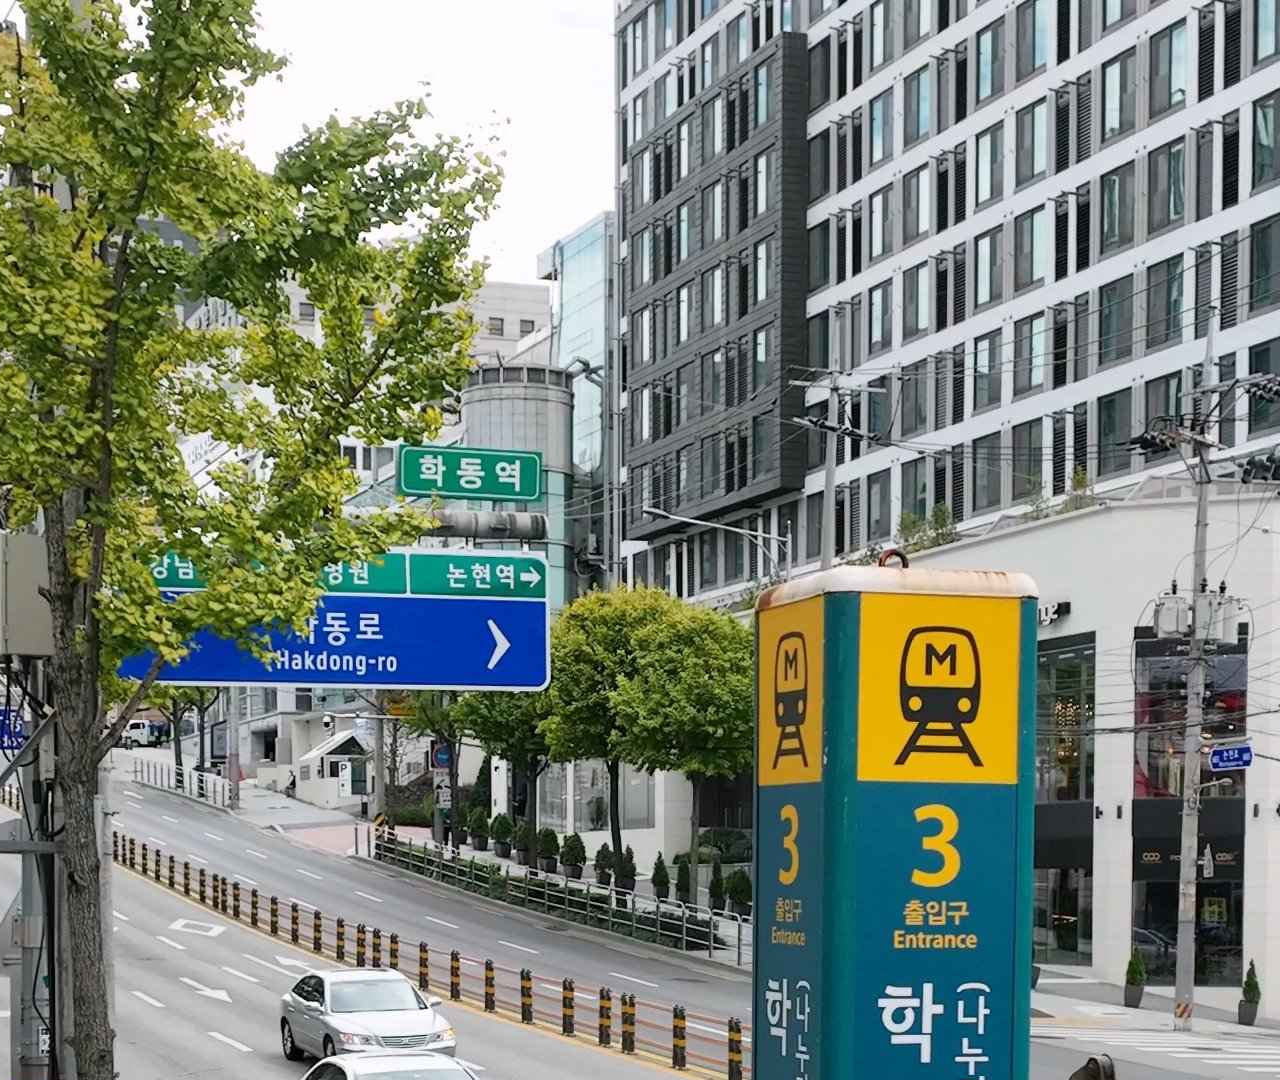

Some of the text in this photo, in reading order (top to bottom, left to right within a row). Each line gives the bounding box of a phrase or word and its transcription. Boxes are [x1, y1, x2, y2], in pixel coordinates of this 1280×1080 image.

[419, 455, 521, 492] 학동역
[447, 563, 515, 589] 논현역
[276, 650, 397, 676] Hakdong-ro
[924, 642, 957, 676] M
[778, 804, 800, 887] 3
[911, 804, 962, 888] 3
[775, 896, 803, 923] 출입구
[903, 900, 969, 926] 출입구
[771, 926, 805, 946] Entrance
[893, 931, 978, 949] Entrance
